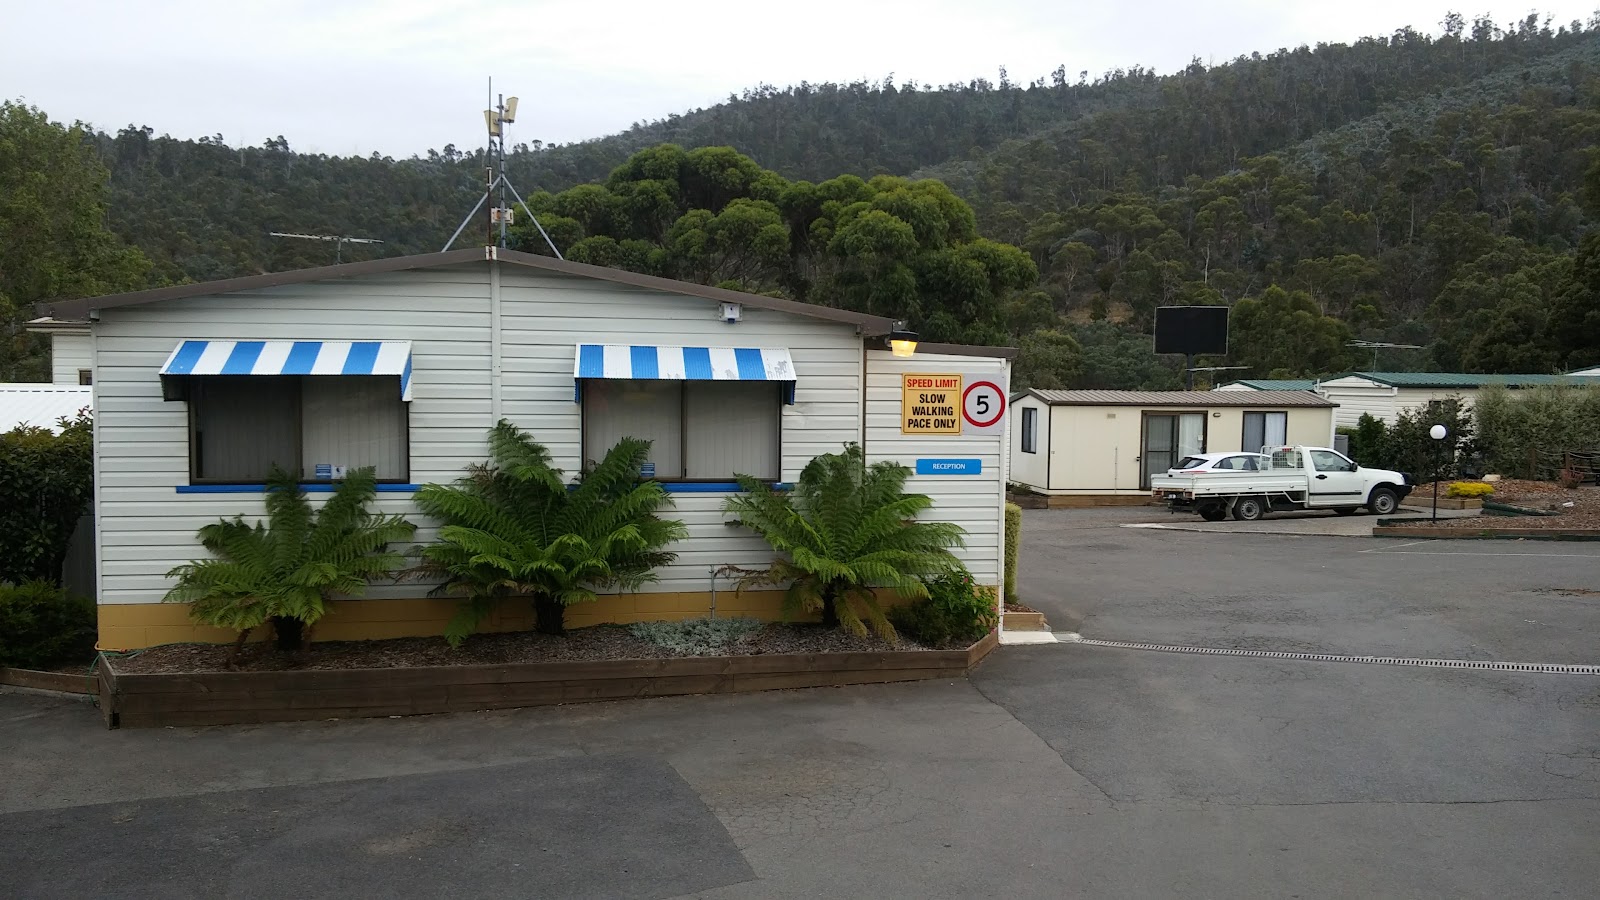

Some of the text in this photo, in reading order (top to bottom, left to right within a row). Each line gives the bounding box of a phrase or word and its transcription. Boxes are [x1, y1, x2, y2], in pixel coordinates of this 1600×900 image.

[907, 379, 958, 388] SPEED LIMIT
[919, 394, 946, 404] SLOW
[976, 395, 989, 414] 5
[912, 406, 954, 416] WALKING
[908, 419, 956, 428] PACE ONLY
